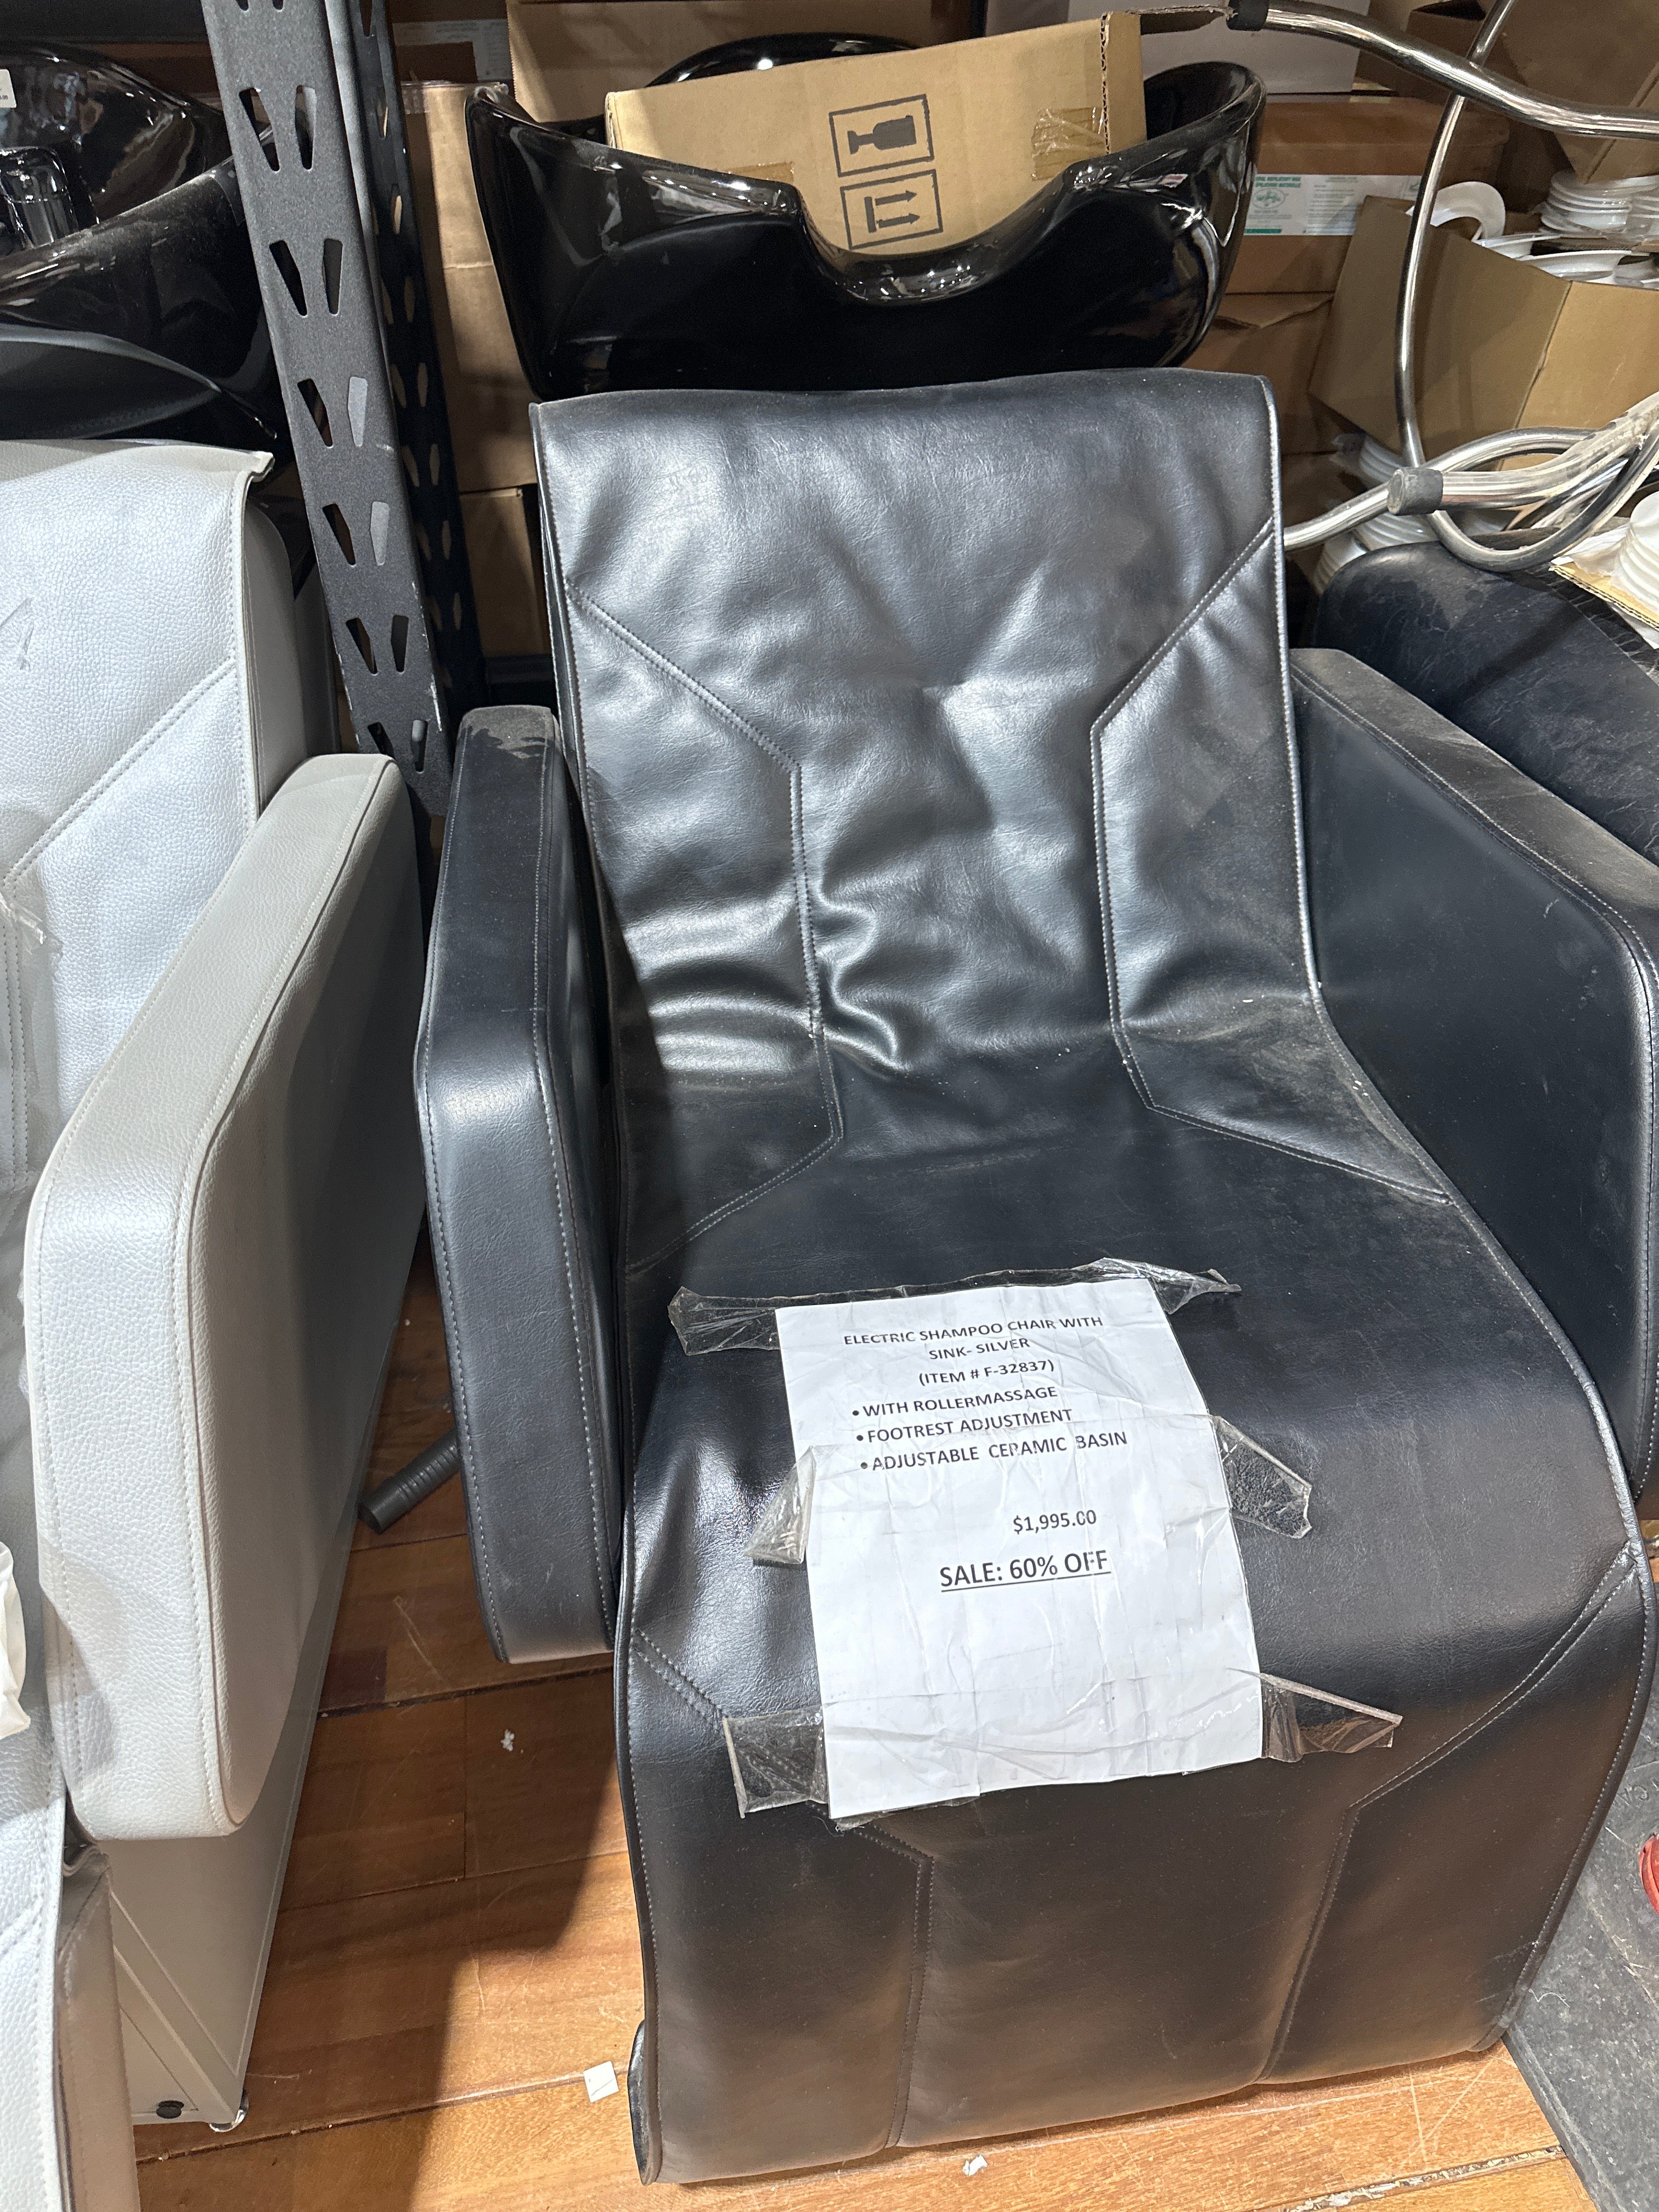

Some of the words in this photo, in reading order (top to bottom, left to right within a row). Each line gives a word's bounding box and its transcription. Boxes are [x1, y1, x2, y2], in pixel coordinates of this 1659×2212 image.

[844, 1332, 915, 1345] ELECTRIC
[919, 1323, 1003, 1341] SHAMPOO
[1007, 1320, 1056, 1330] CHAIR
[1059, 1317, 1103, 1328] WITH
[929, 1347, 972, 1359] SINK-
[976, 1338, 1030, 1353] SILVER
[919, 1372, 965, 1386] (ITEM
[970, 1369, 979, 1379] #
[984, 1359, 1054, 1378] F-32837)
[863, 1402, 908, 1417] WITH
[913, 1386, 1058, 1412] ROLLERMASSAGE
[868, 1421, 953, 1443] FOOTREST
[960, 1409, 1073, 1432] ADJUSTMENT
[873, 1447, 979, 1470] ADJUSTABLE
[989, 1437, 1066, 1458] CERAMIC
[1075, 1432, 1127, 1449] BASIN
[1013, 1509, 1097, 1534] $1,995.00
[939, 1562, 1003, 1587] SALE:
[1009, 1555, 1058, 1579] 60%
[1064, 1550, 1108, 1573] OFF
